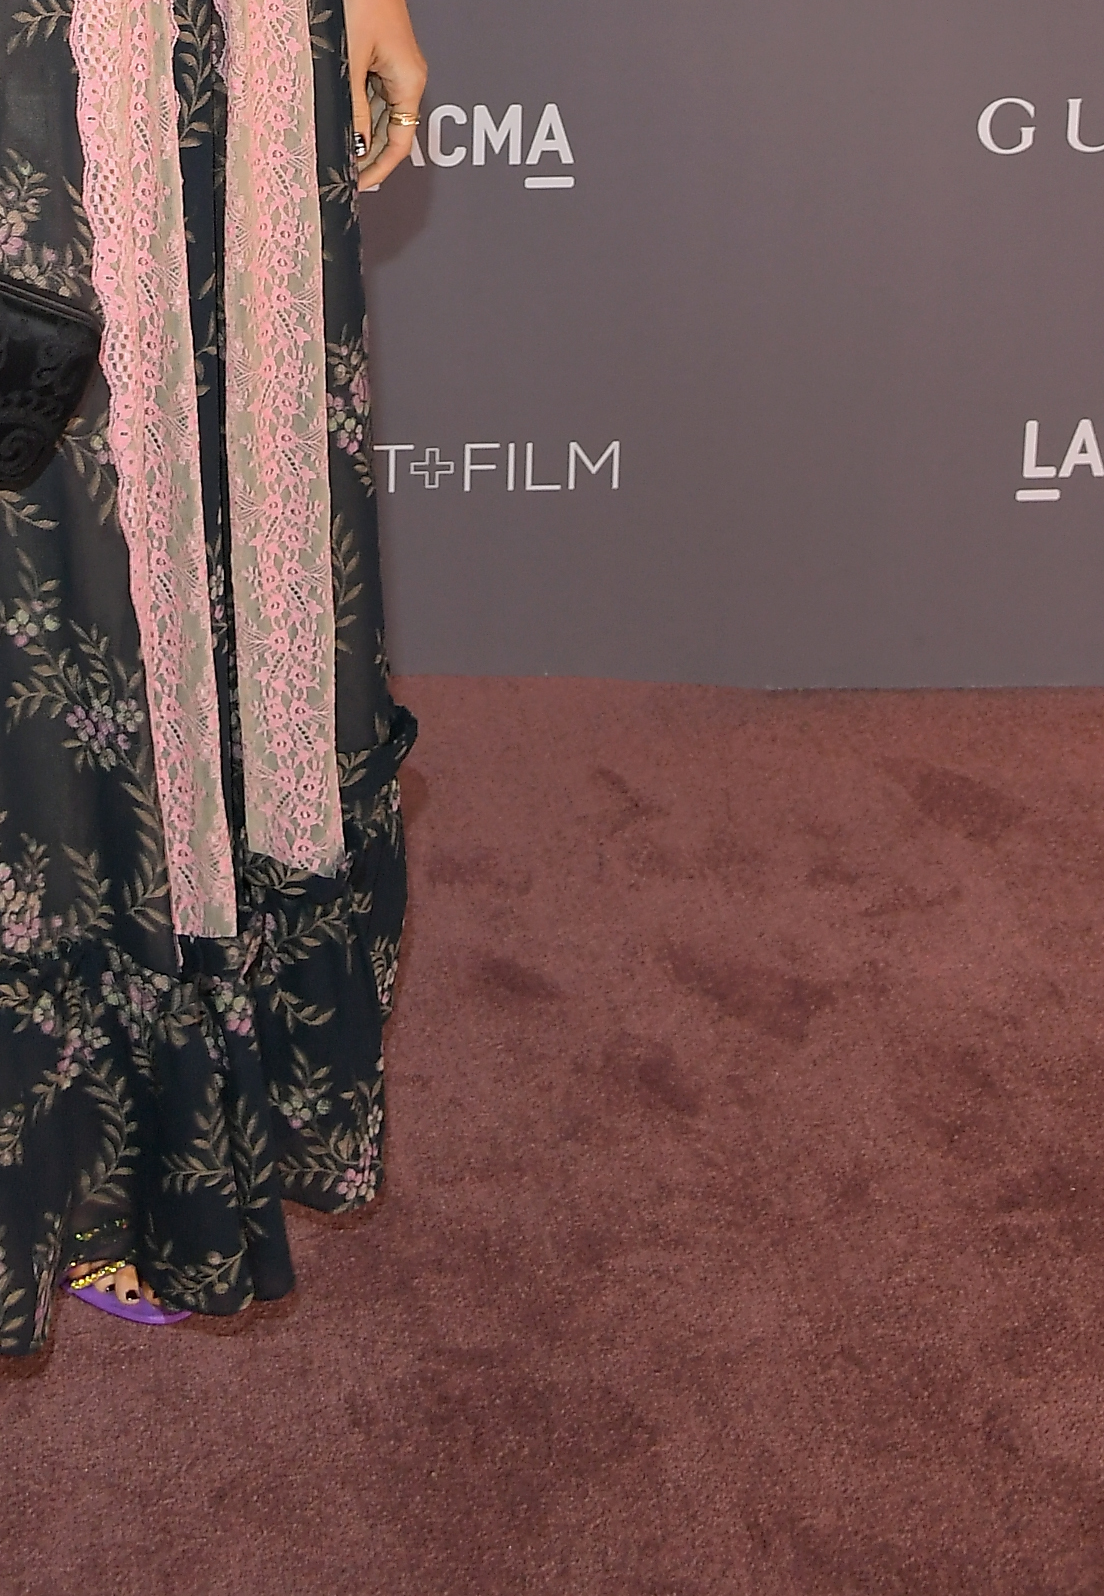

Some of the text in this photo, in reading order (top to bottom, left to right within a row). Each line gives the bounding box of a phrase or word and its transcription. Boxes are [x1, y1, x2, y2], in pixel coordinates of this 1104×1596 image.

[411, 103, 574, 167] CMA
[977, 97, 1104, 155] GU
[373, 440, 620, 493] T+FILM
[1022, 418, 1104, 478] LA
